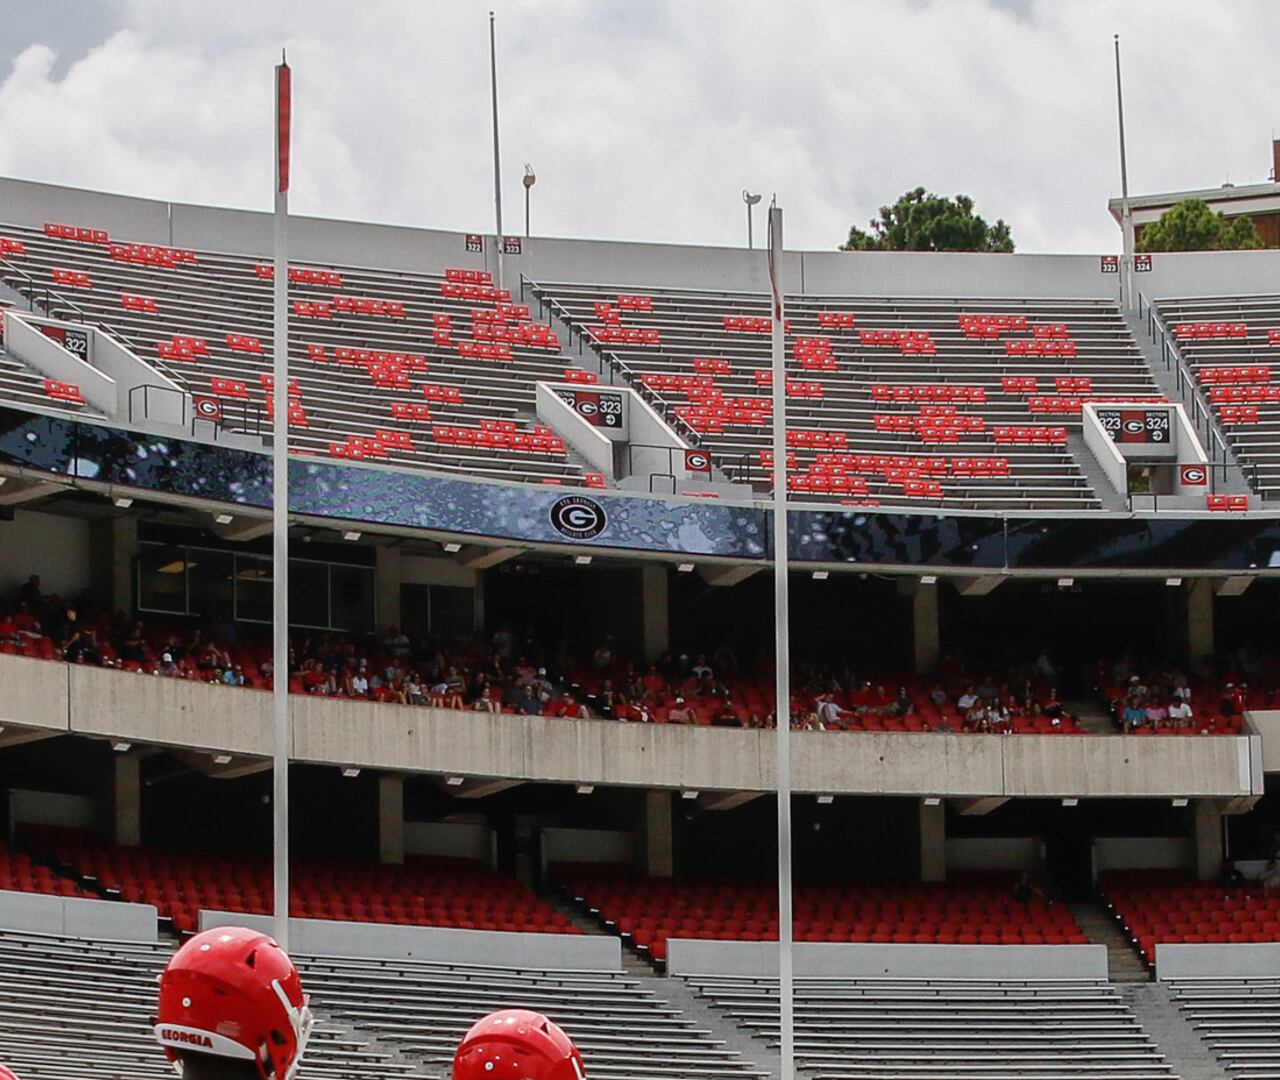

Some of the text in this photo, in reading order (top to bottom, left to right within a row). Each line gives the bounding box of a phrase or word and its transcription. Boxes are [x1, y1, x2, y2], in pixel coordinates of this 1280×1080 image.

[65, 338, 86, 353] 322
[600, 401, 621, 414] 323
[1100, 418, 1121, 430] 323
[1146, 418, 1168, 430] 324
